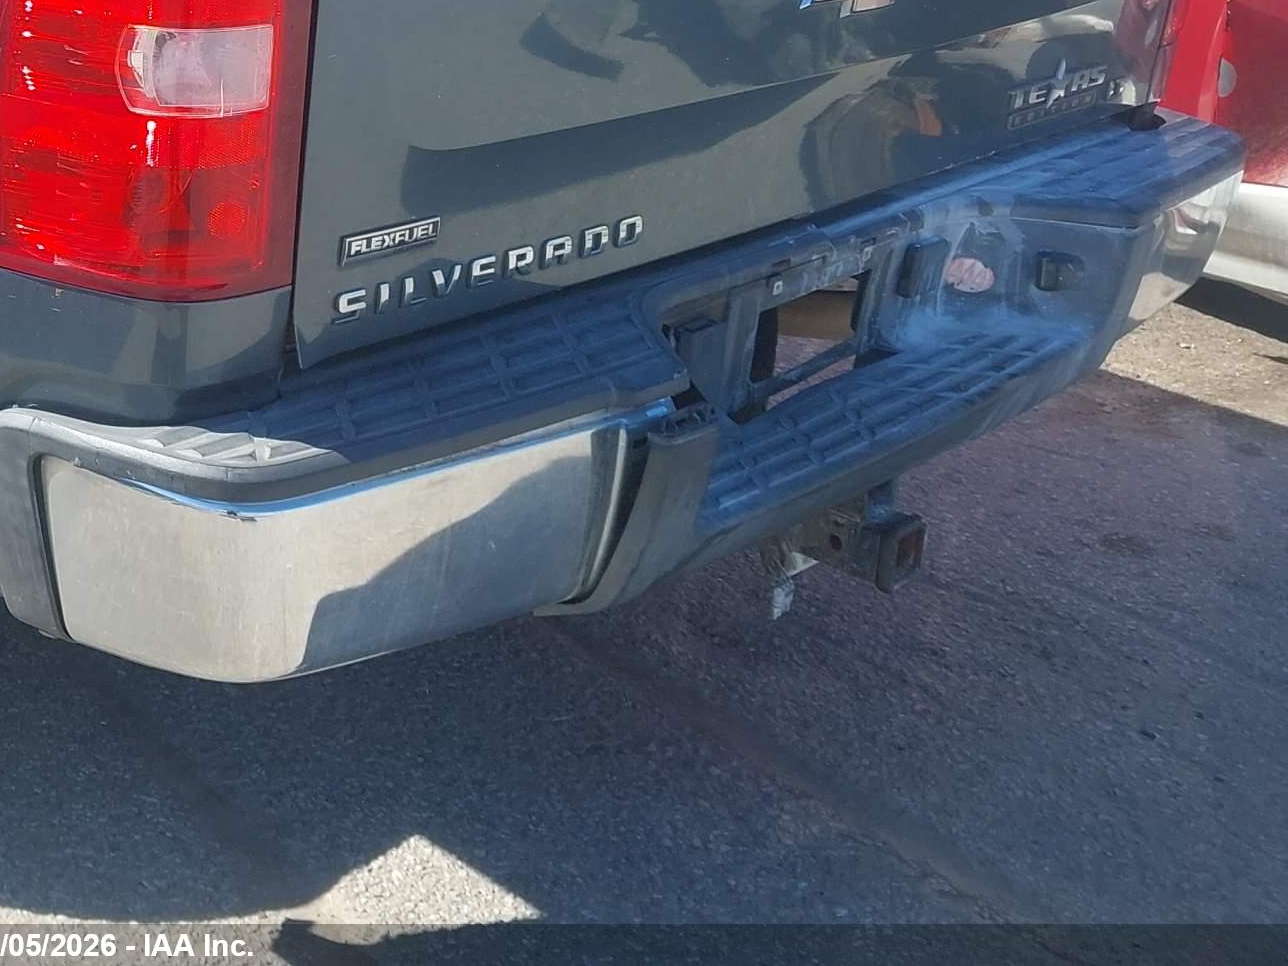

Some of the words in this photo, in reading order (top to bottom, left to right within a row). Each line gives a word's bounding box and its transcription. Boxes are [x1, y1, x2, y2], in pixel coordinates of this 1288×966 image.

[1007, 58, 1108, 110] TEXAS
[349, 223, 438, 257] FLEXFUEL
[332, 214, 645, 325] SILVERADO
